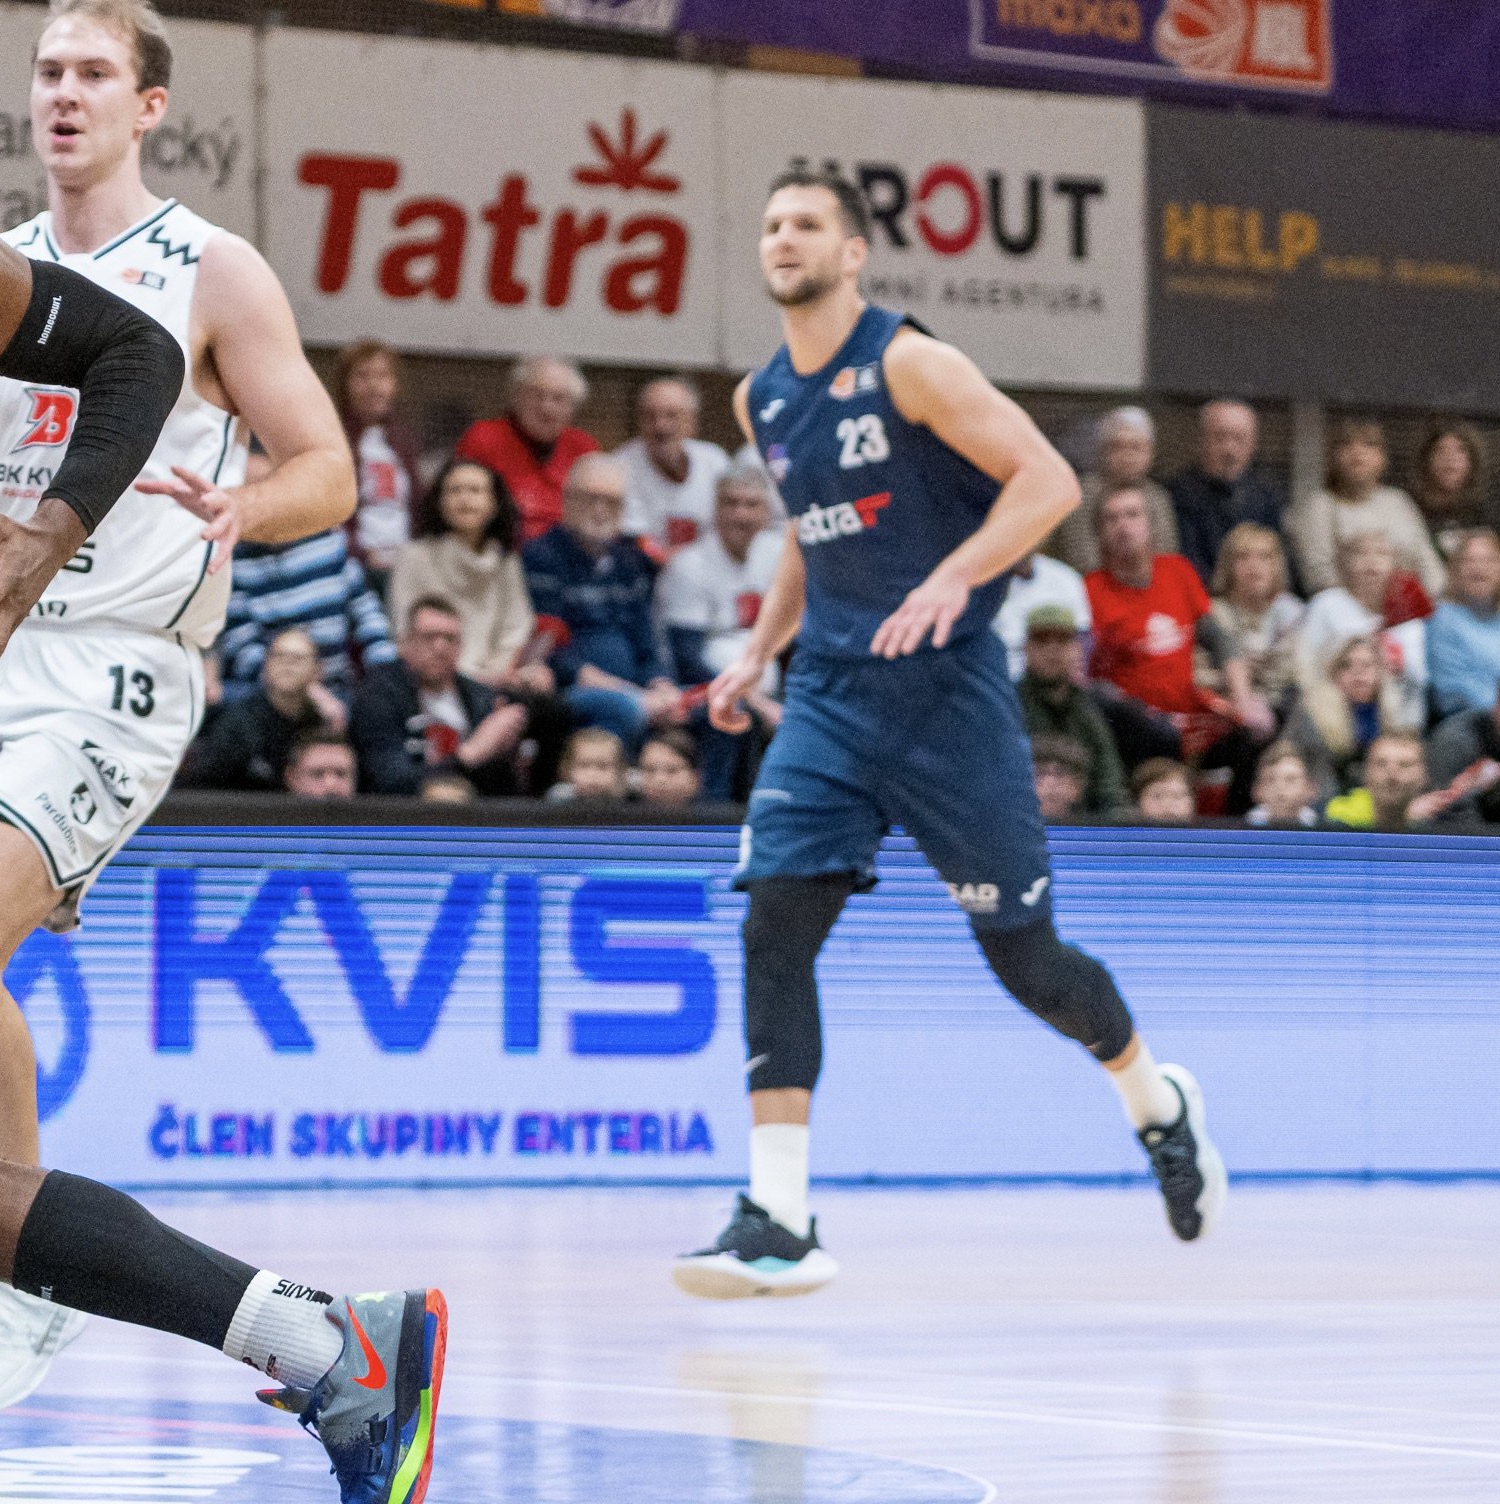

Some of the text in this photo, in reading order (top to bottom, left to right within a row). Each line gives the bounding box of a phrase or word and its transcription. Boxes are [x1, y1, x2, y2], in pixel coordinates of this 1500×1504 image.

[300, 149, 688, 317] Tatra
[788, 156, 1108, 262] ROUT
[1162, 202, 1318, 272] HELP
[836, 413, 891, 470] 23
[108, 664, 156, 717] 13
[152, 866, 719, 1057] KVIS
[149, 1103, 715, 1159] ČLEN SKUPINY ENTERIA
